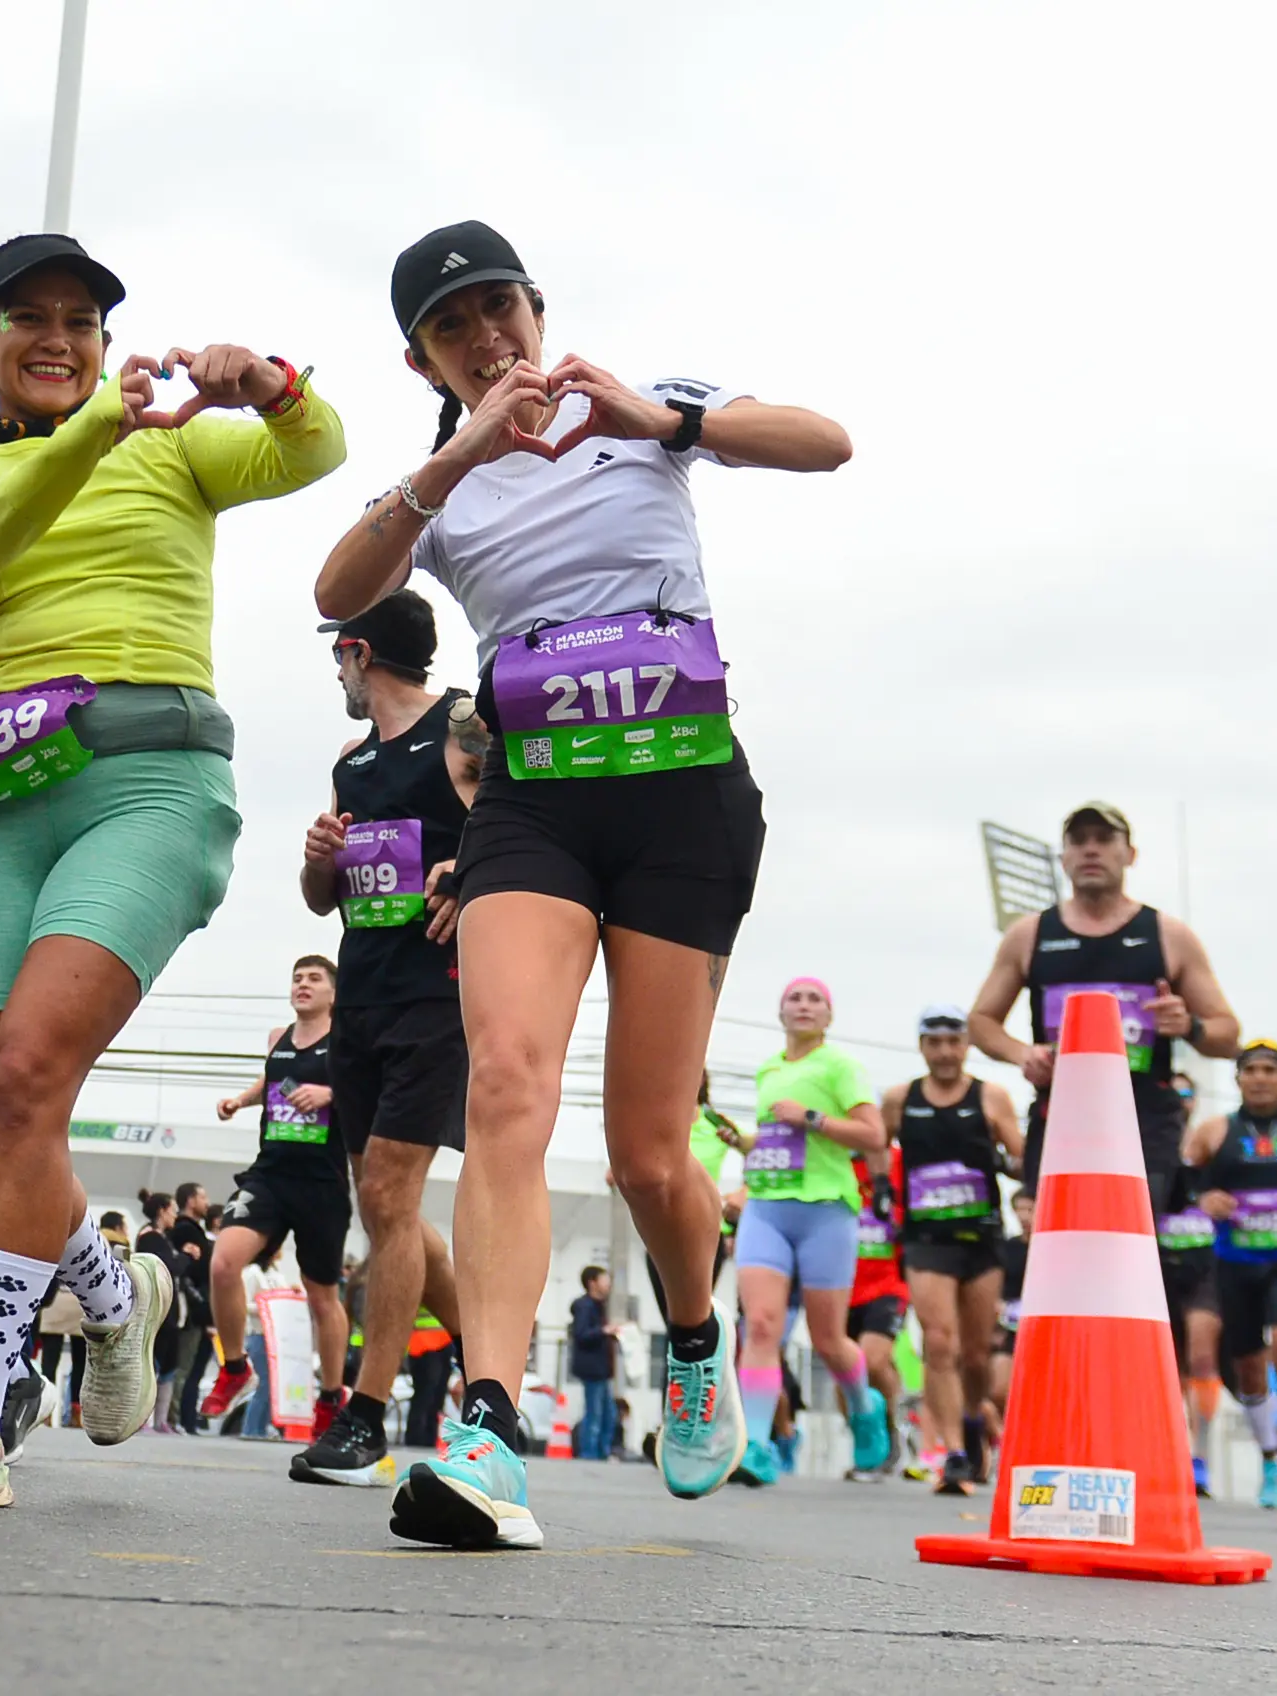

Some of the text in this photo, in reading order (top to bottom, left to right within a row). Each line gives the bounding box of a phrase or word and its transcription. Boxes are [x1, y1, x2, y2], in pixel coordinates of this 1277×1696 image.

[556, 625, 623, 643] MARATÓN
[556, 634, 623, 651] DE SANTIAGO
[541, 664, 677, 722] 2117
[346, 863, 398, 895] 1199
[1069, 1473, 1131, 1496] HEAVY
[1069, 1492, 1129, 1514] DUTY
